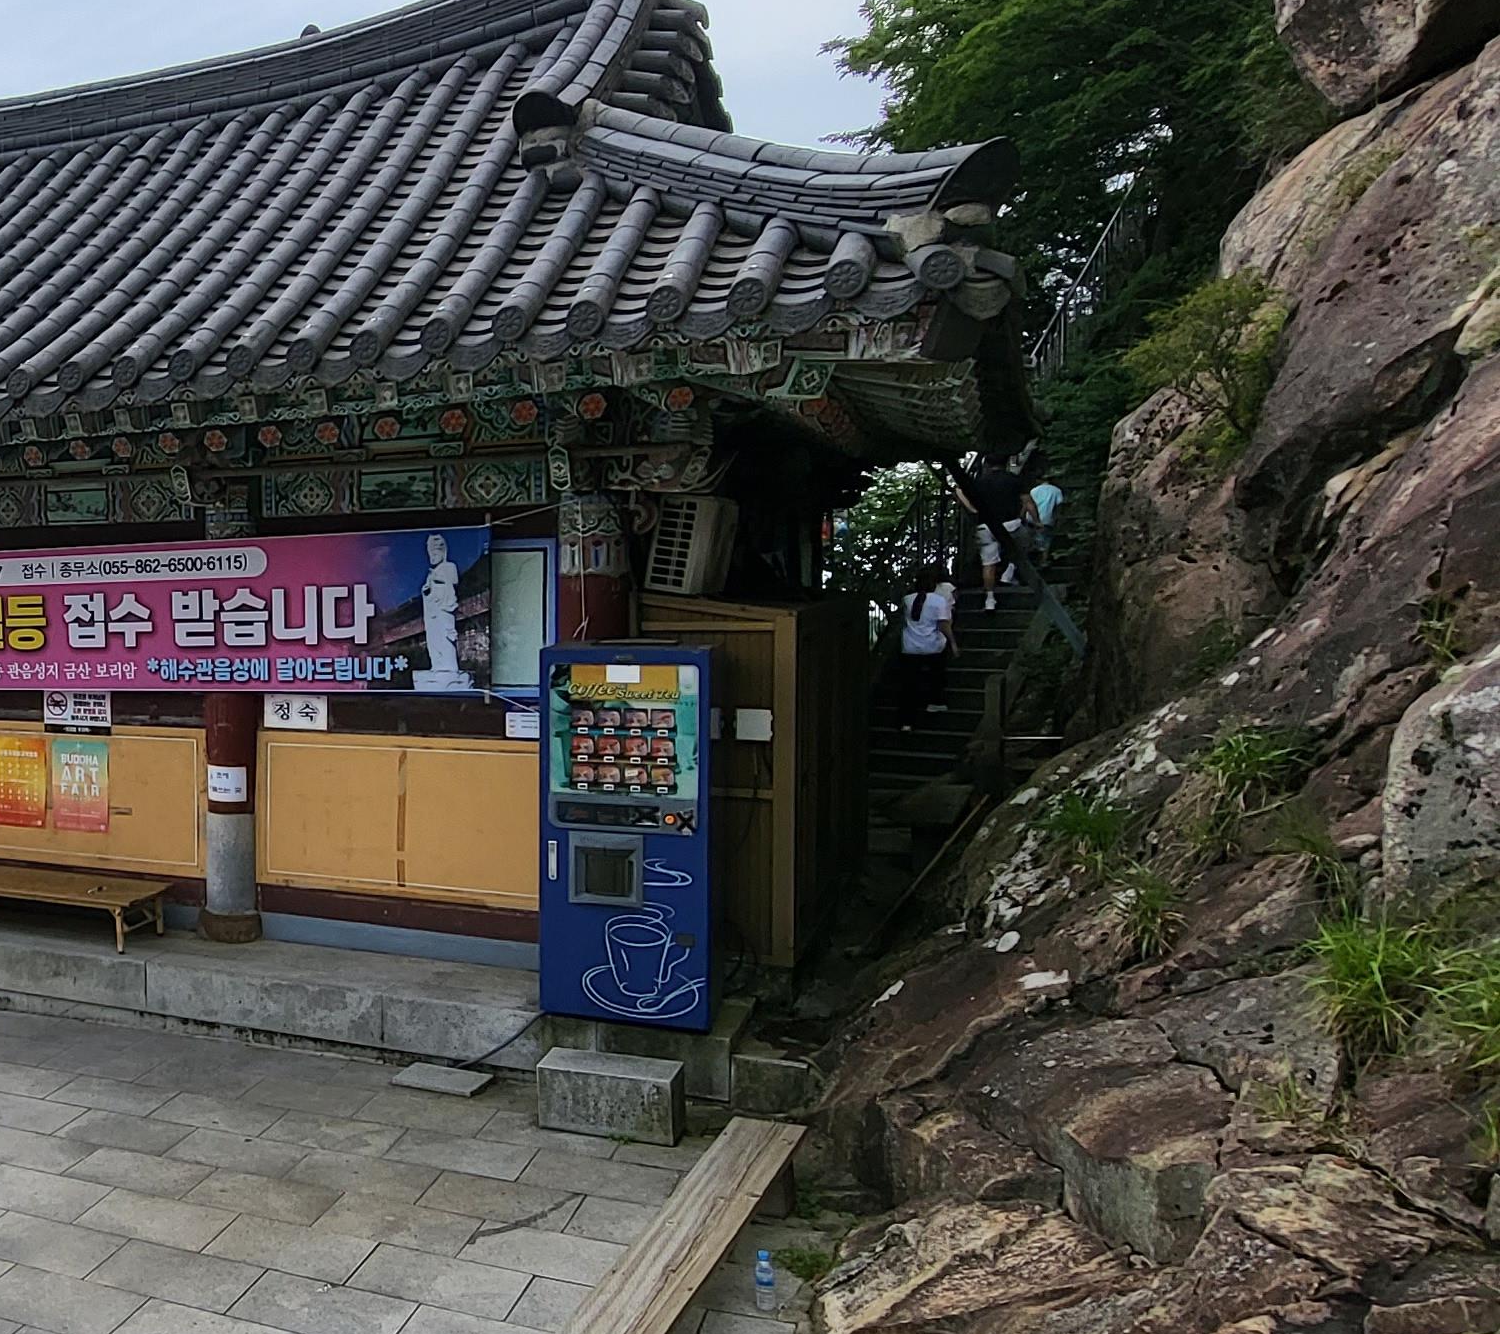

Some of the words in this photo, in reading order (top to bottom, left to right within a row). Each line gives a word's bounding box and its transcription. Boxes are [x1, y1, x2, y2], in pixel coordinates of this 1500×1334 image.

[21, 562, 47, 580] 접수
[63, 593, 154, 649] 접수
[171, 584, 375, 648] 받습니다
[7, 662, 60, 681] 관음성지
[65, 663, 91, 680] 금산
[95, 661, 138, 680] 보리암
[567, 682, 616, 699] Coffee
[616, 690, 653, 699] Sweet
[657, 690, 681, 699] Tea
[273, 701, 318, 722] 정숙
[61, 753, 99, 765] BUDDHA
[62, 766, 99, 783] ART
[61, 784, 100, 797] FAIR
